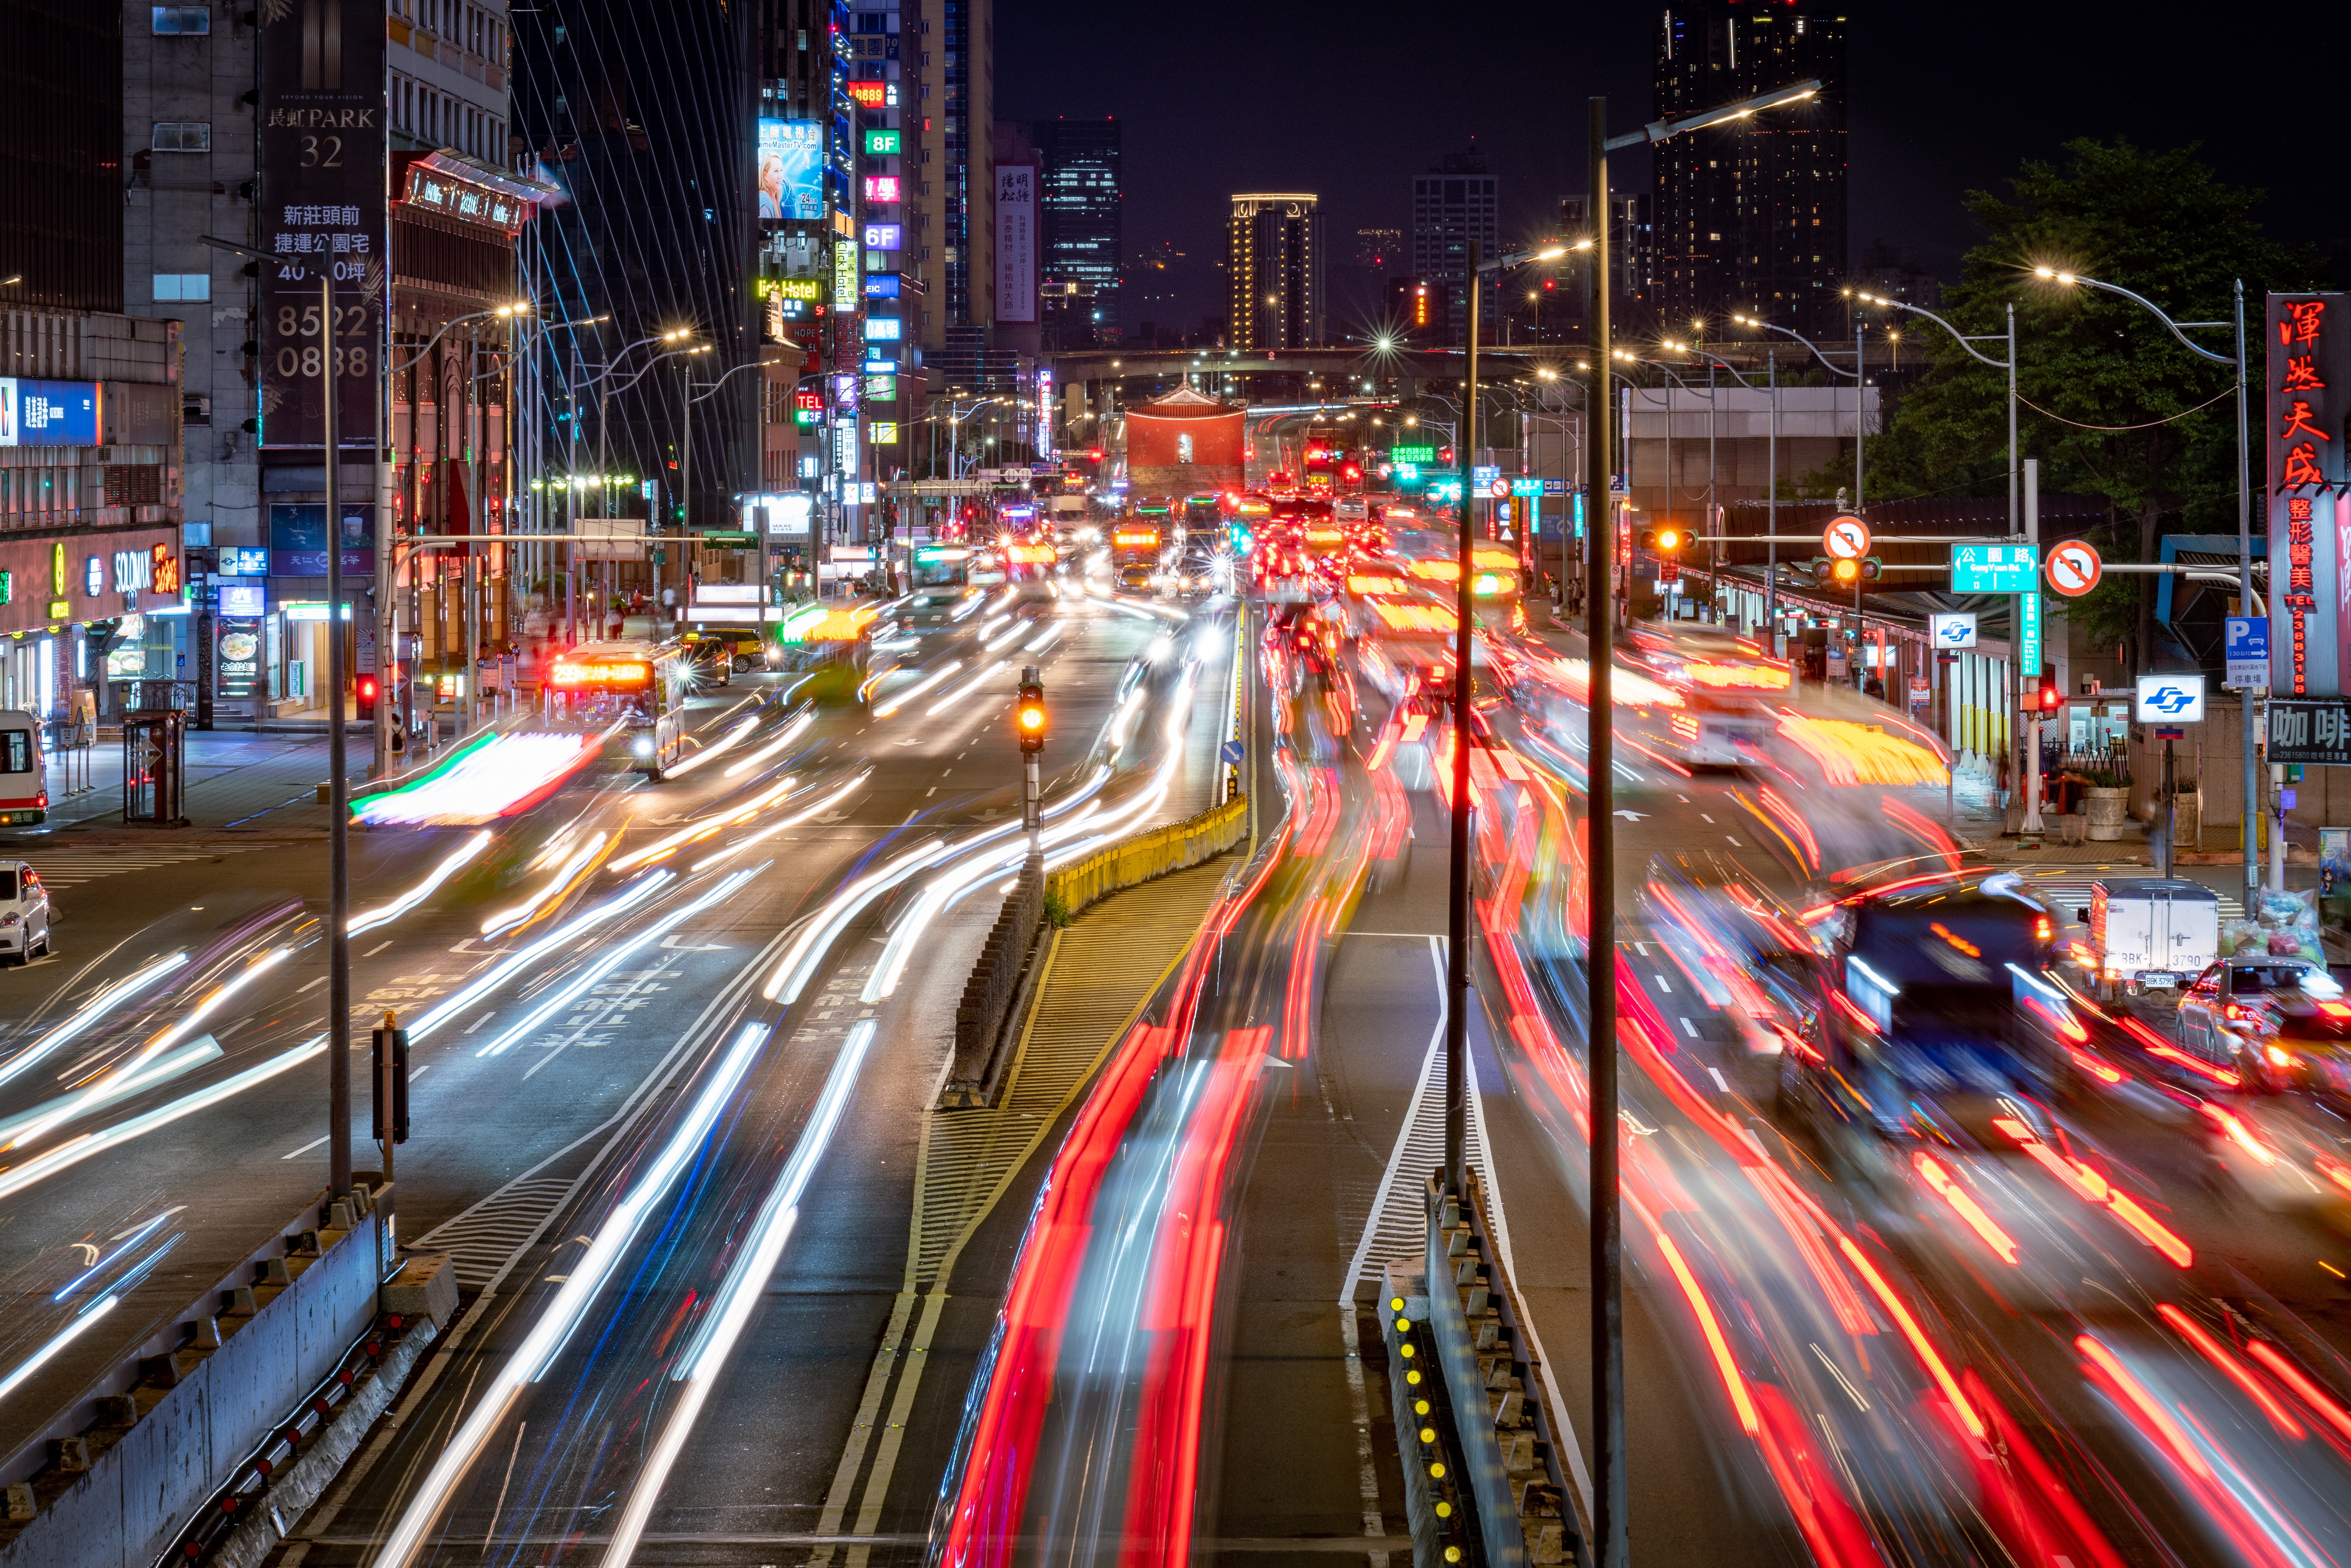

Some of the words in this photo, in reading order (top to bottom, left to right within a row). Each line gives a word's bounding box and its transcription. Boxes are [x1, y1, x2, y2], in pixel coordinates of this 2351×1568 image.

[851, 38, 882, 56] 集團
[849, 89, 882, 101] 8689
[268, 108, 305, 127] 長虹
[308, 109, 376, 127] PARK
[759, 125, 816, 140] 上師電視台
[300, 135, 343, 167] 32
[873, 137, 895, 151] 8F
[284, 205, 360, 225] 新莊頭前
[866, 229, 894, 246] 6F
[1004, 215, 1013, 252] 潤泰精材
[275, 233, 369, 253] 捷運公園宅
[838, 242, 847, 267] Click
[782, 281, 816, 298] Hotel
[838, 270, 847, 298] Hotel
[1004, 263, 1013, 310] 楊柏林大師
[815, 305, 825, 316] 5F
[794, 329, 816, 337] HOPE
[798, 396, 822, 408] TEL
[809, 412, 822, 422] 3F
[870, 424, 891, 437] 2F
[845, 430, 854, 463] 巴菲特
[1610, 475, 1618, 485] P
[2288, 498, 2312, 589] 整形醫美
[240, 551, 265, 561] 捷運
[291, 556, 313, 565] 天仁
[1961, 547, 2029, 563] 公園路
[116, 550, 150, 593] SOLOMAX
[2008, 563, 2021, 571] Rd.
[2285, 595, 2315, 606] TEL
[2228, 621, 2250, 646] P
[2293, 610, 2305, 694] 23883188
[554, 665, 578, 682] 299
[2234, 674, 2262, 684] 停車場
[2272, 706, 2351, 749] 咖啡
[2311, 751, 2348, 761] 咖啡豆專賣
[2172, 954, 2201, 966] 3790
